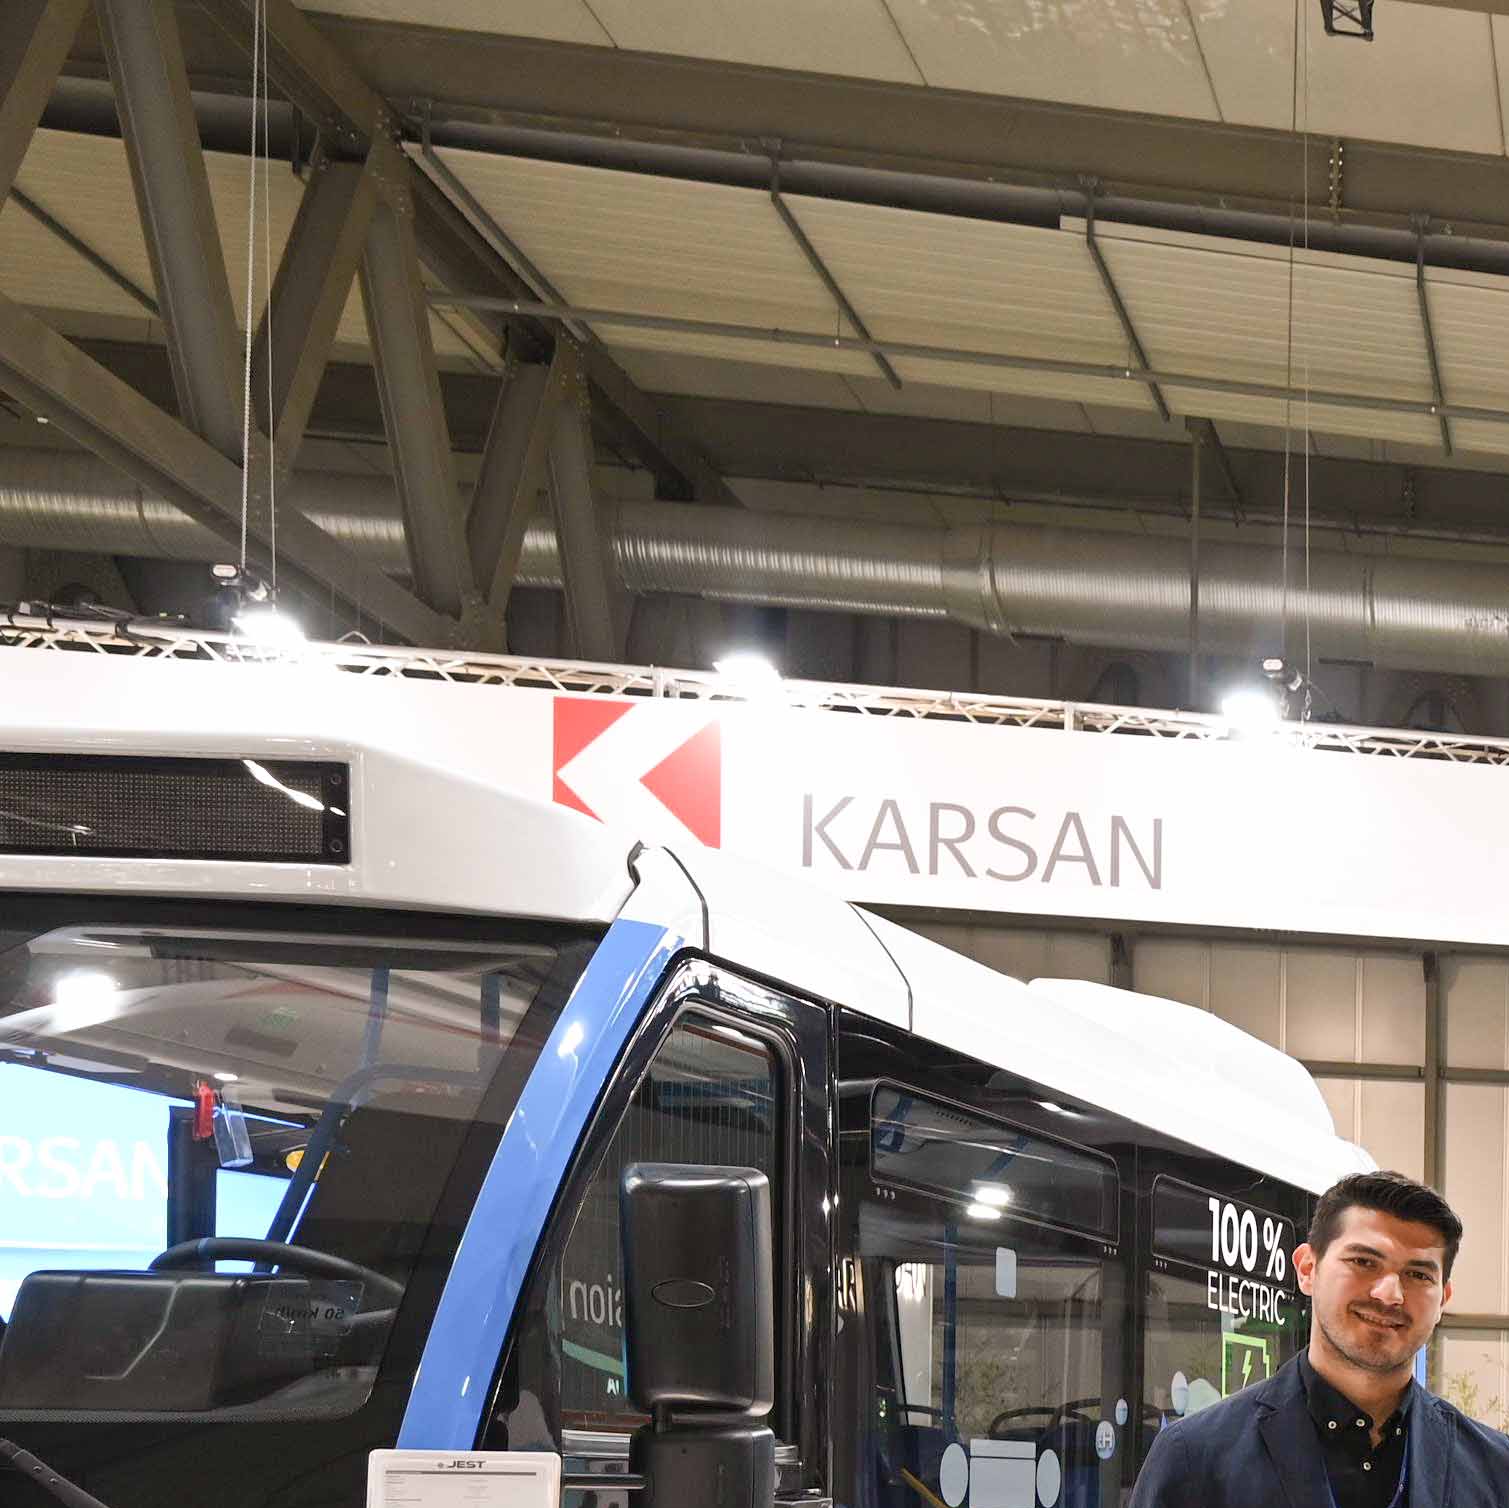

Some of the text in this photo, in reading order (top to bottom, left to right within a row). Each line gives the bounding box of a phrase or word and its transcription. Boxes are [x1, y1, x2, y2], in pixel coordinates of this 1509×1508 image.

[803, 794, 1163, 890] KARSAN
[1208, 1196, 1286, 1282] 100 %
[1207, 1269, 1286, 1326] ELECTRIC
